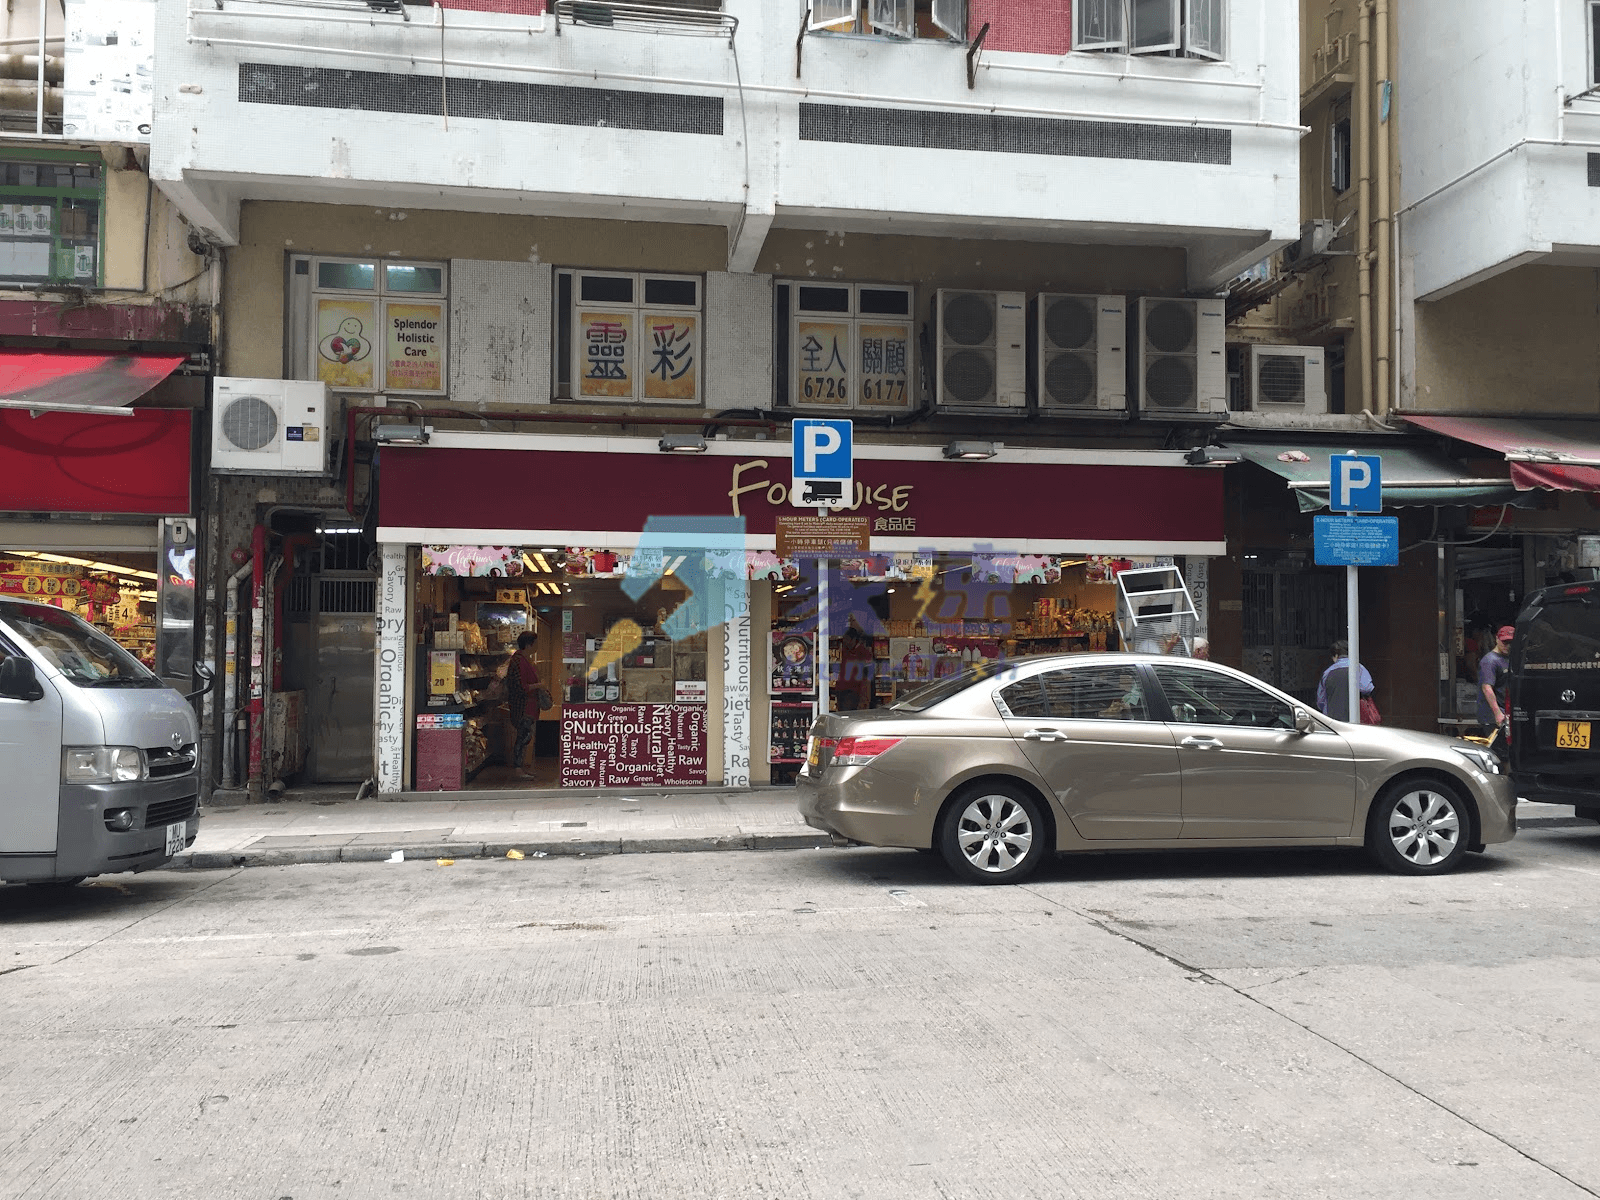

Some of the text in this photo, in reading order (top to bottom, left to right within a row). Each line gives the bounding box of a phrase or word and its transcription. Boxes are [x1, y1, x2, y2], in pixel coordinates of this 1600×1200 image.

[394, 319, 437, 331] Splendor
[397, 333, 434, 343] Holistic
[404, 347, 427, 356] Care
[804, 377, 905, 400] 6726 6177
[804, 426, 842, 472] P
[1341, 461, 1371, 506] P
[873, 517, 916, 532] 食品店
[385, 571, 396, 603] Savory
[1194, 581, 1206, 613] Raw
[121, 607, 128, 619] 4
[739, 616, 750, 692] Nutritious
[380, 649, 396, 720] Organic
[434, 678, 445, 687] 20
[564, 709, 605, 721] Healthy
[638, 706, 646, 723] Raw
[674, 705, 703, 713] Organic
[574, 721, 651, 734] Nutritious
[663, 704, 674, 736] Savory
[731, 712, 744, 743] Tasty
[1566, 722, 1581, 735] UK
[652, 704, 664, 757] Natural
[689, 712, 700, 751] Organic
[561, 721, 574, 764] Organic
[573, 741, 608, 752] Healthy
[620, 734, 628, 759] Savory
[629, 738, 638, 758] Tasty
[1559, 735, 1587, 748] 6393
[589, 751, 597, 769] Raw
[609, 735, 618, 767] Green
[665, 738, 676, 774] Healthy
[679, 755, 702, 765] Raw
[392, 753, 400, 786] Healthy
[563, 767, 590, 776] Green
[616, 762, 657, 774] Organic
[657, 755, 665, 777] Diet
[563, 778, 595, 787] Savory
[609, 775, 630, 783] Raw
